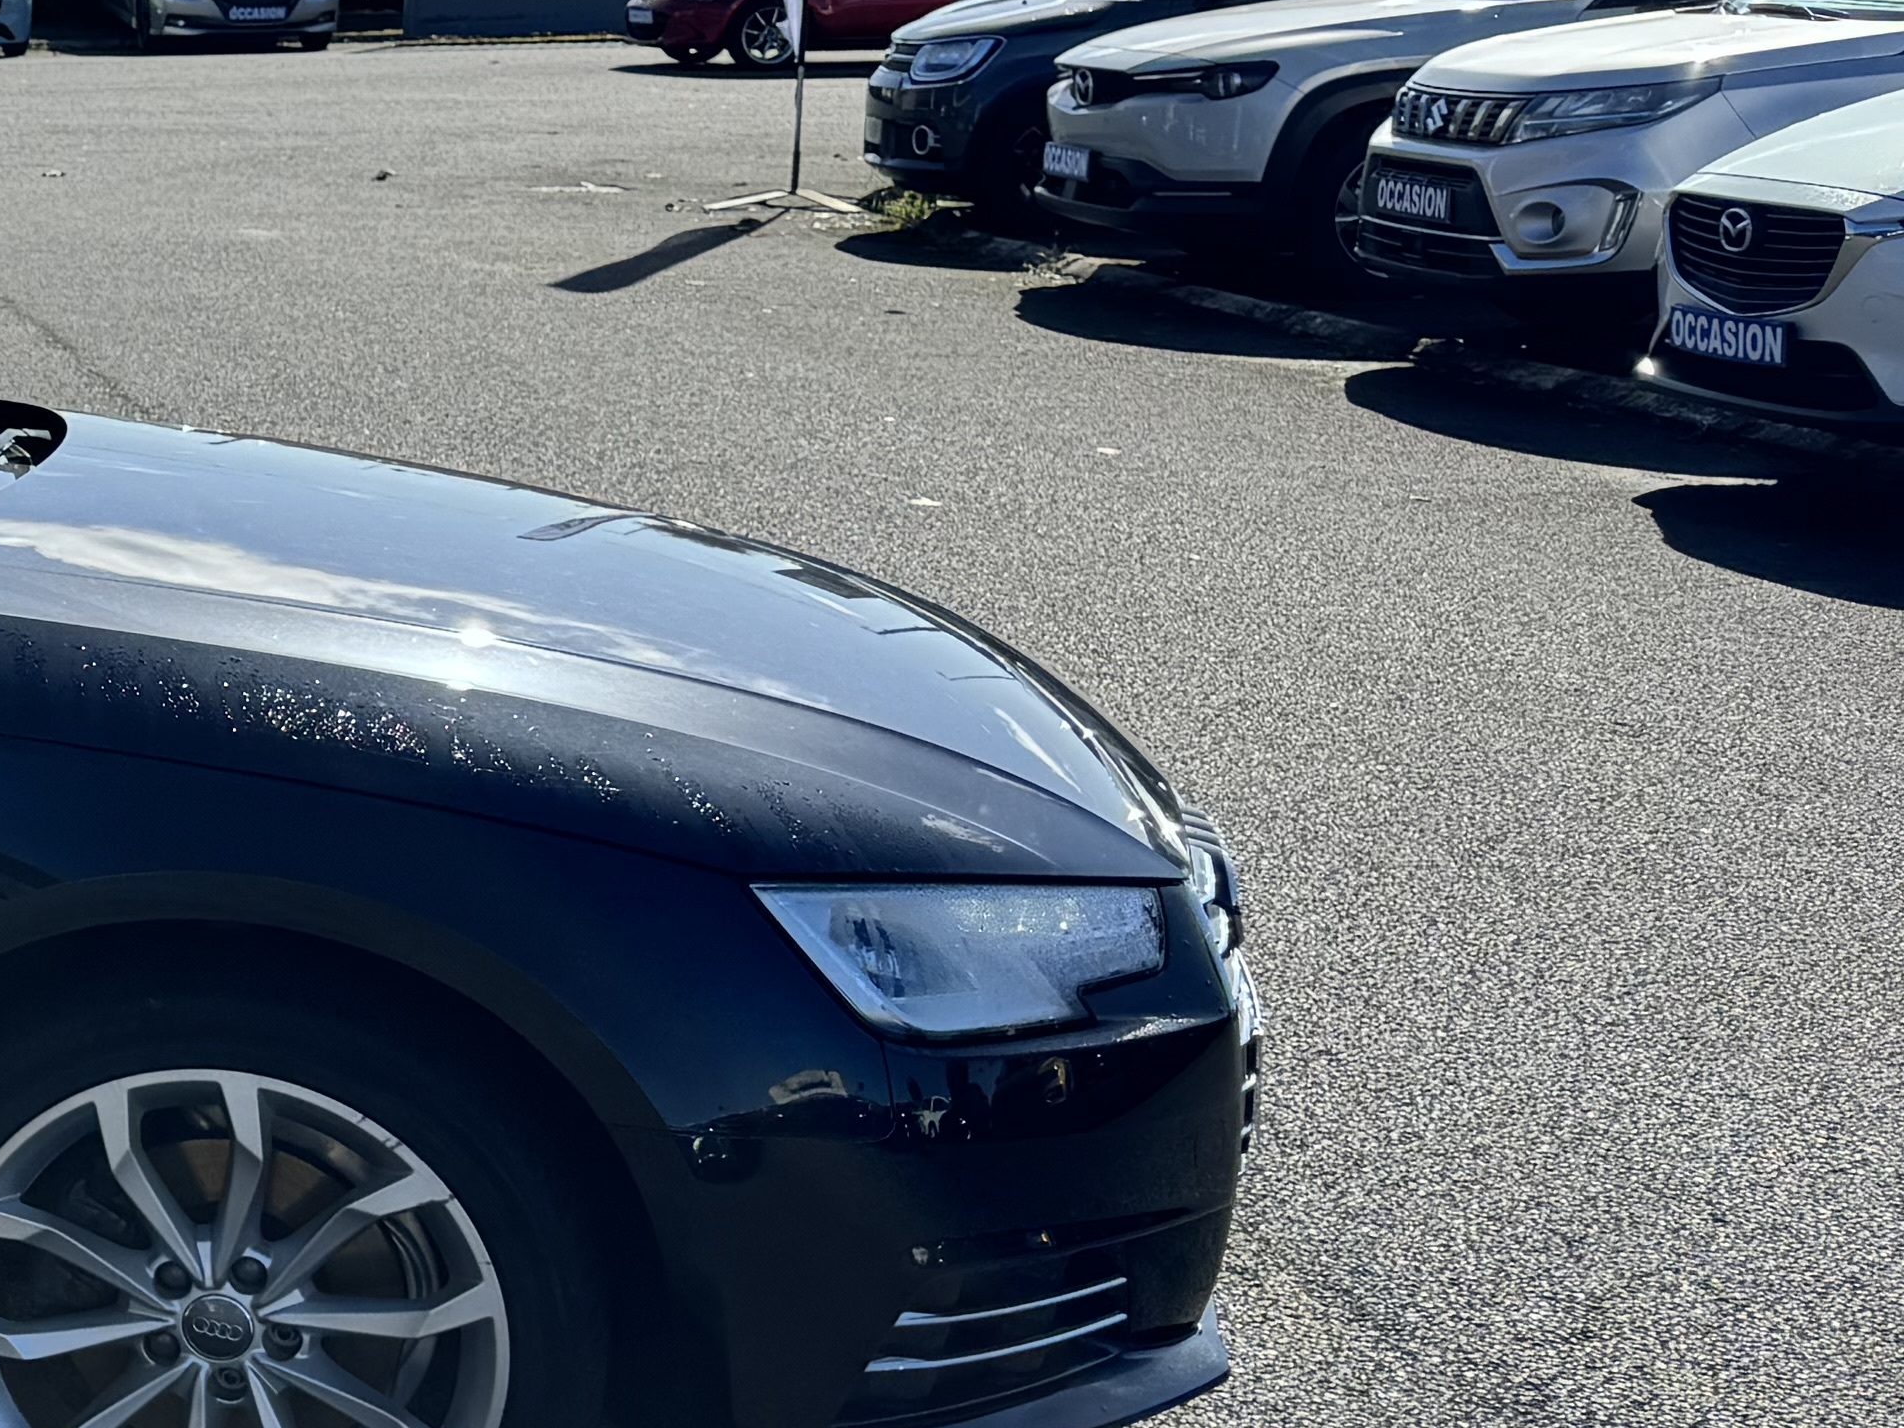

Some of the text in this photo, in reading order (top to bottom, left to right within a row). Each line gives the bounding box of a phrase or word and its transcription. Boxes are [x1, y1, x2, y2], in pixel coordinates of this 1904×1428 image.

[1044, 142, 1089, 178] OCCASION
[1376, 179, 1448, 221] OCCASION
[1671, 310, 1783, 363] OCCASION
